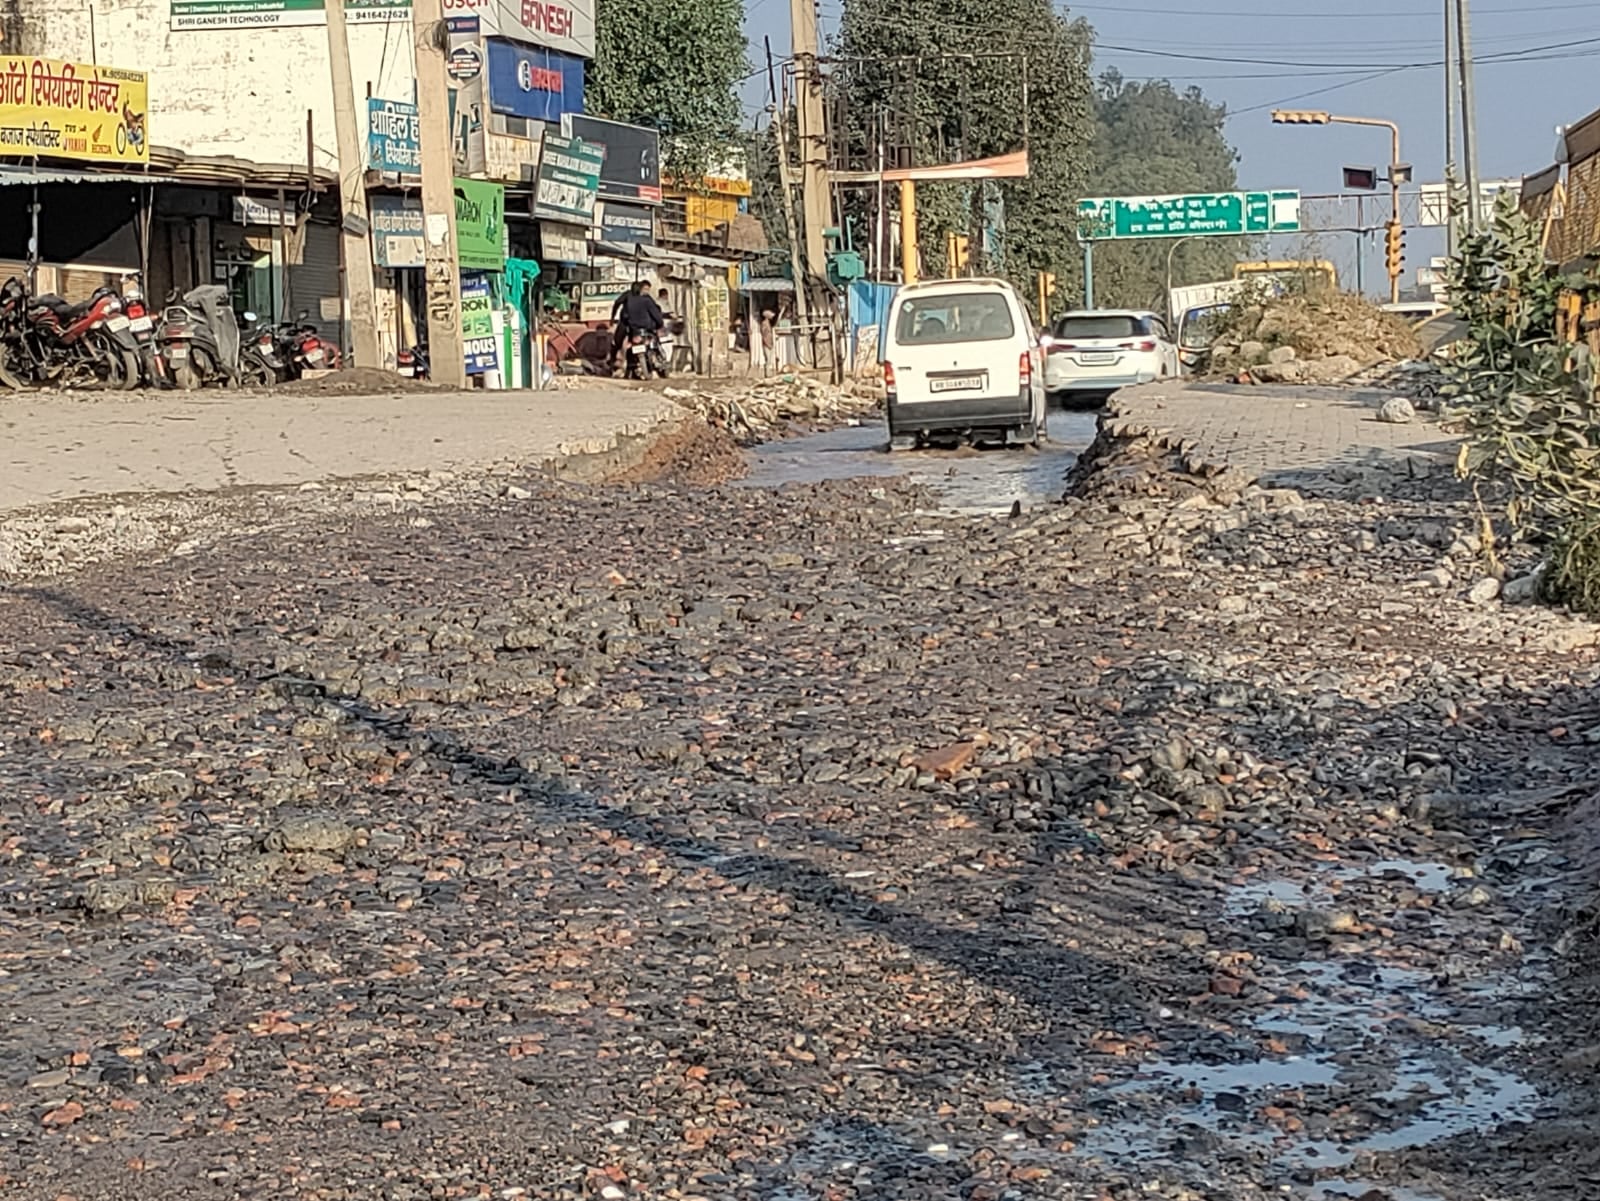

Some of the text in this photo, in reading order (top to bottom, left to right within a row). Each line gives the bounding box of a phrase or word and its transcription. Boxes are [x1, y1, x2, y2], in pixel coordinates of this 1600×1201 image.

[178, 14, 280, 26] SHRI GANESH TECHNOLOGY
[520, 0, 573, 38] GANESH
[88, 69, 120, 113] सेन्टर
[456, 199, 482, 223] MARON
[461, 299, 489, 312] RON
